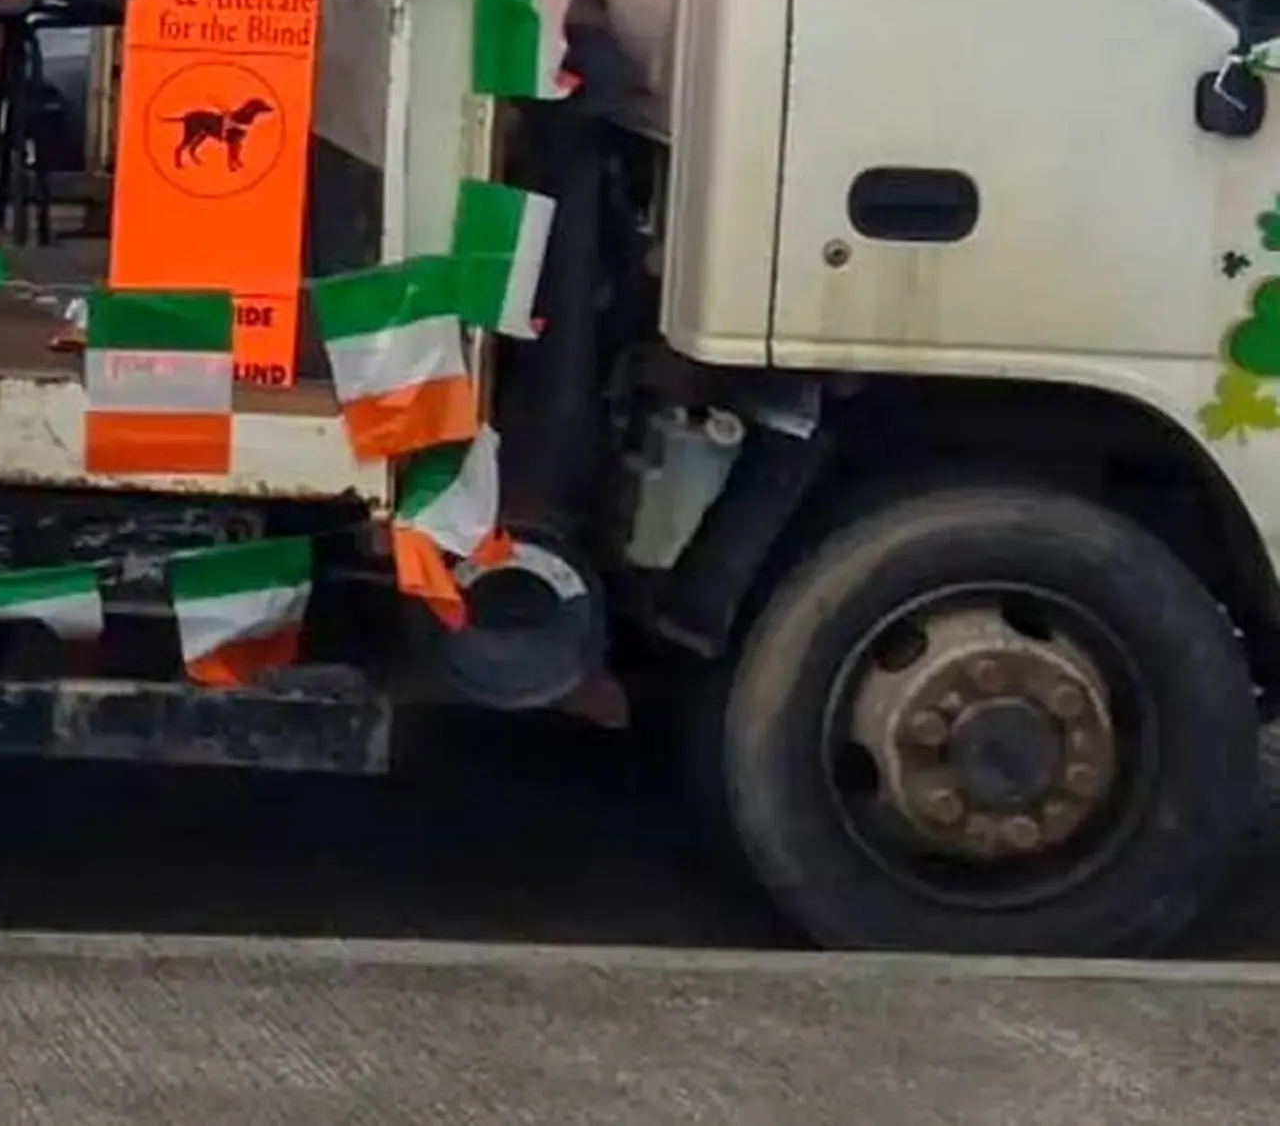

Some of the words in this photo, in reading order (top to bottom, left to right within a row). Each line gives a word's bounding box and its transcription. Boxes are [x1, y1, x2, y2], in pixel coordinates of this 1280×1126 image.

[160, 9, 195, 40] for
[200, 14, 239, 43] the
[247, 13, 312, 46] Blind
[237, 305, 274, 327] IDE
[233, 362, 287, 384] LIND
